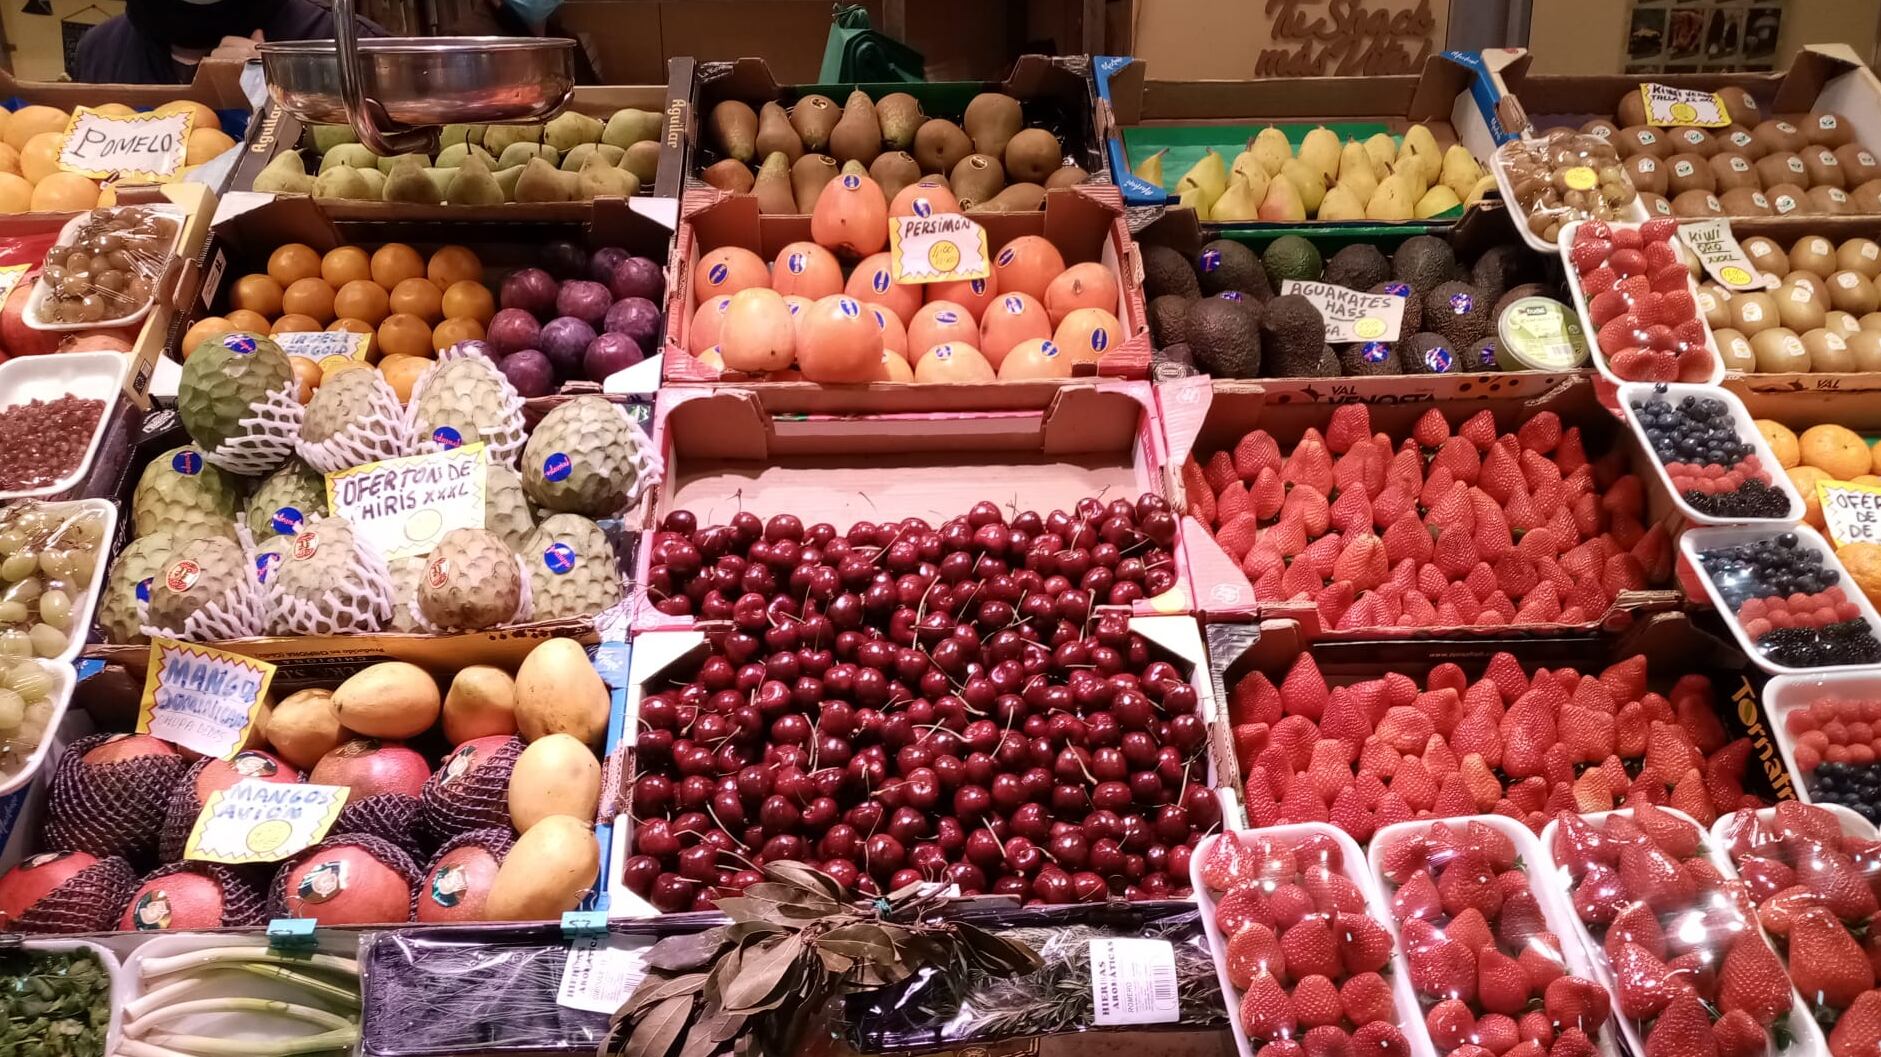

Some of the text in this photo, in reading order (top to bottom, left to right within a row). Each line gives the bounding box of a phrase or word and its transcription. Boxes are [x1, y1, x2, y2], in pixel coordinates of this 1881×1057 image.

[250, 104, 282, 153] Aguilar
[667, 98, 687, 149] Aguilar
[70, 127, 173, 159] POMELO
[1290, 282, 1392, 309] AGUAKATES
[1325, 300, 1366, 319] HASS
[1332, 385, 1357, 396] VAL
[1816, 379, 1840, 389] VAL
[448, 460, 472, 480] DE
[357, 482, 469, 520] HIRIS XXXL
[1856, 511, 1877, 523] DE
[1849, 524, 1873, 538] DE
[165, 657, 256, 703] MANGO
[230, 785, 329, 805] MANGOS
